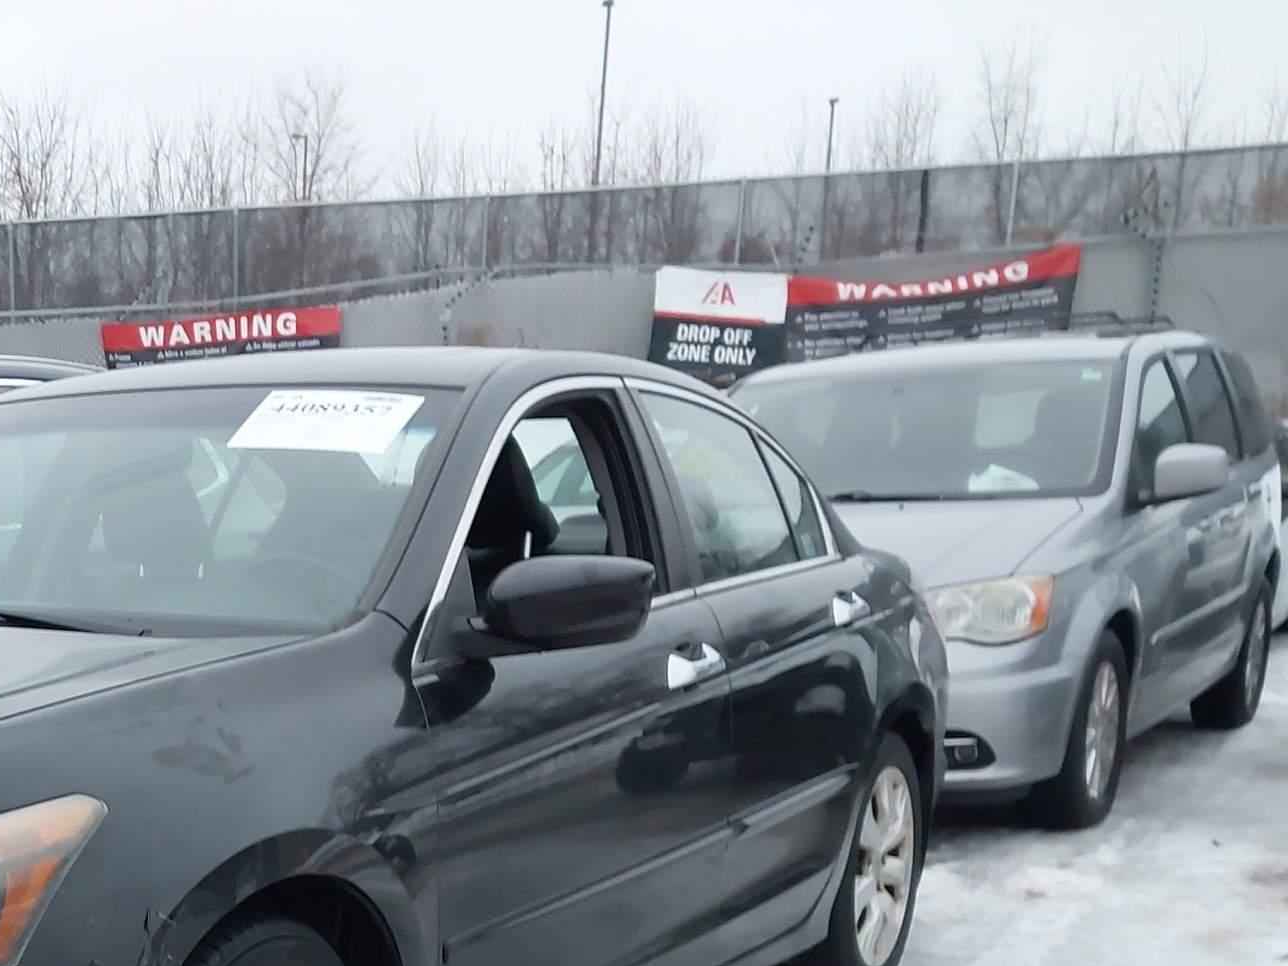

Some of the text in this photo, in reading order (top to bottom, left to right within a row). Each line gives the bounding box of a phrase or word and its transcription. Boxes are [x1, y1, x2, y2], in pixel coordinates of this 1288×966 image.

[836, 260, 1030, 303] WARNING
[138, 311, 298, 348] WARNING
[676, 322, 753, 346] DROP OFF
[666, 341, 757, 366] ZONE ONLY
